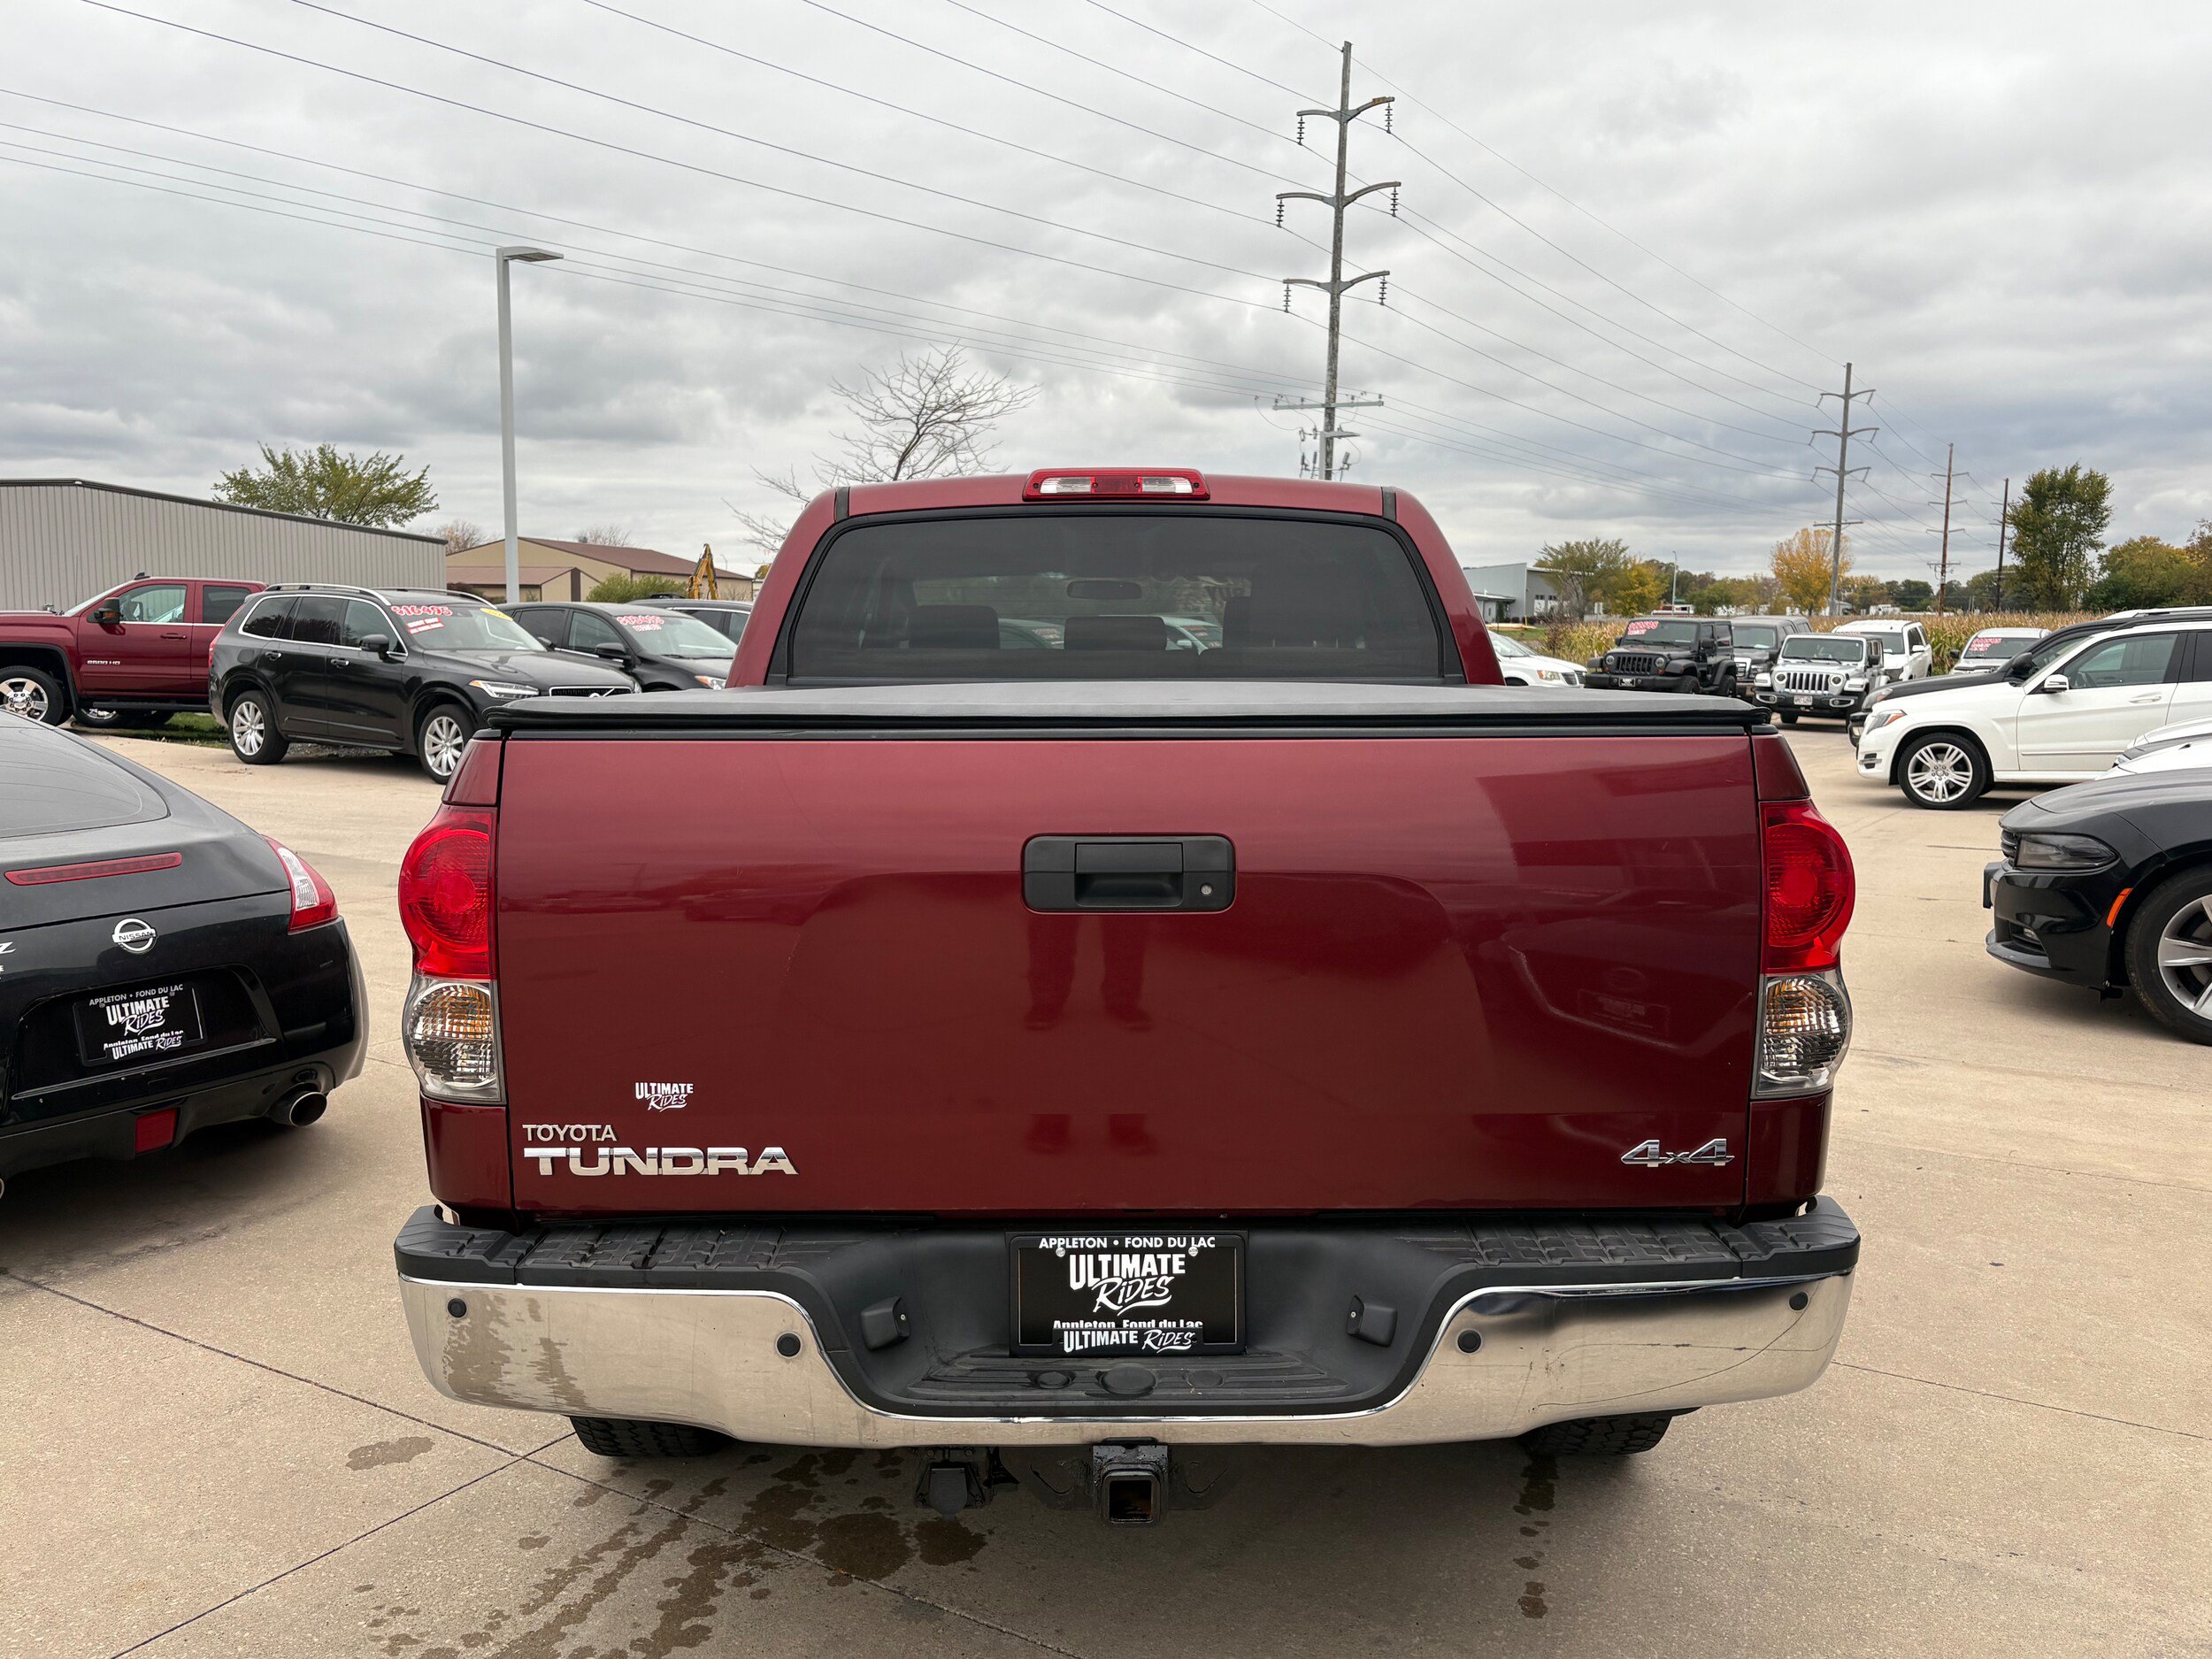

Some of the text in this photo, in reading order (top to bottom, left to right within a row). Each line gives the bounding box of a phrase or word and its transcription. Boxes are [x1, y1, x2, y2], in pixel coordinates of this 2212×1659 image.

[119, 931, 154, 941] NISSAN
[88, 984, 184, 1007] APPLETON FOND DU LAC
[105, 996, 171, 1026] ULTIMATE
[111, 1040, 154, 1060] ULTIMATE
[634, 1082, 694, 1100] ULTIMATE
[522, 1124, 618, 1142] TOYOTA
[524, 1147, 799, 1177] TUNDRA
[1621, 1138, 1735, 1168] 4x4
[1039, 1237, 1216, 1249] APPLETON FOND DU LAC
[1069, 1254, 1186, 1291] ULTIMATE
[1064, 1330, 1139, 1353] ULTIMATE
